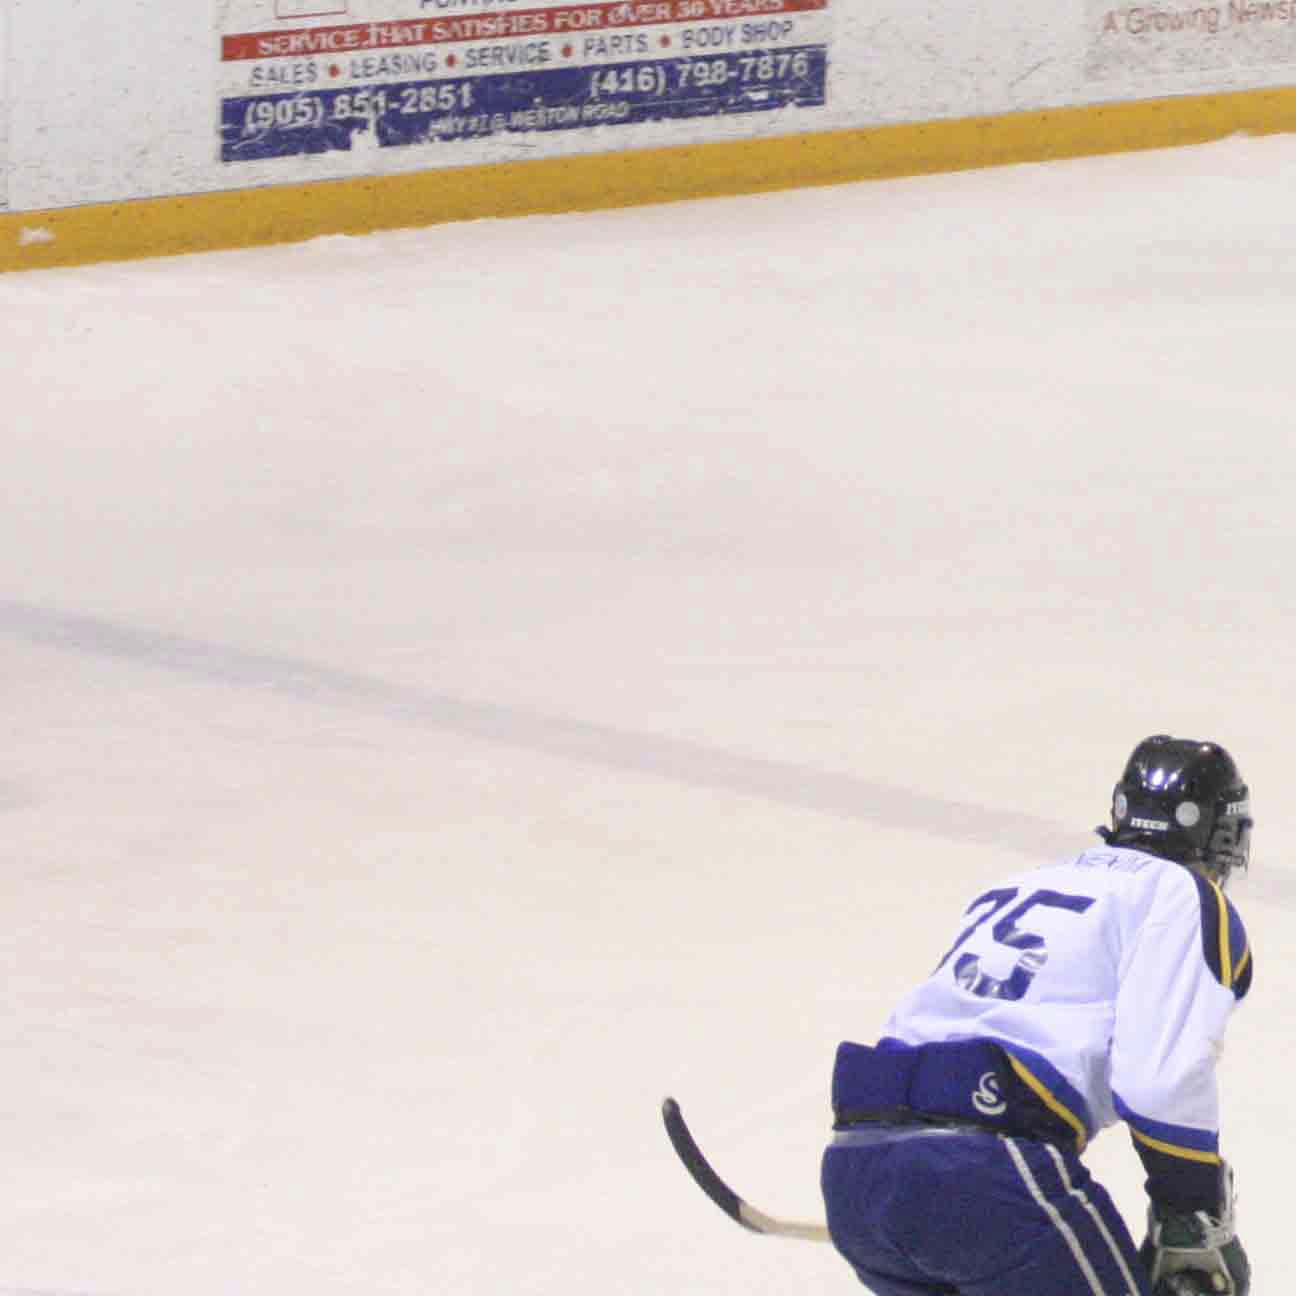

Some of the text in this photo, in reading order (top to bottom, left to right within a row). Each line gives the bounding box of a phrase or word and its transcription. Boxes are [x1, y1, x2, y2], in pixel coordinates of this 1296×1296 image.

[257, 28, 361, 55] SERVICE
[366, 21, 426, 47] THAT
[432, 13, 547, 41] SATISFIES
[553, 8, 602, 31] FOR
[606, 2, 671, 25] OVER
[1125, 5, 1218, 34] Growing
[250, 19, 794, 85] SALES LEASING SERVICE PARTS BODY SHOP
[243, 51, 809, 131] (905) 851-2851 (416) 798-7876
